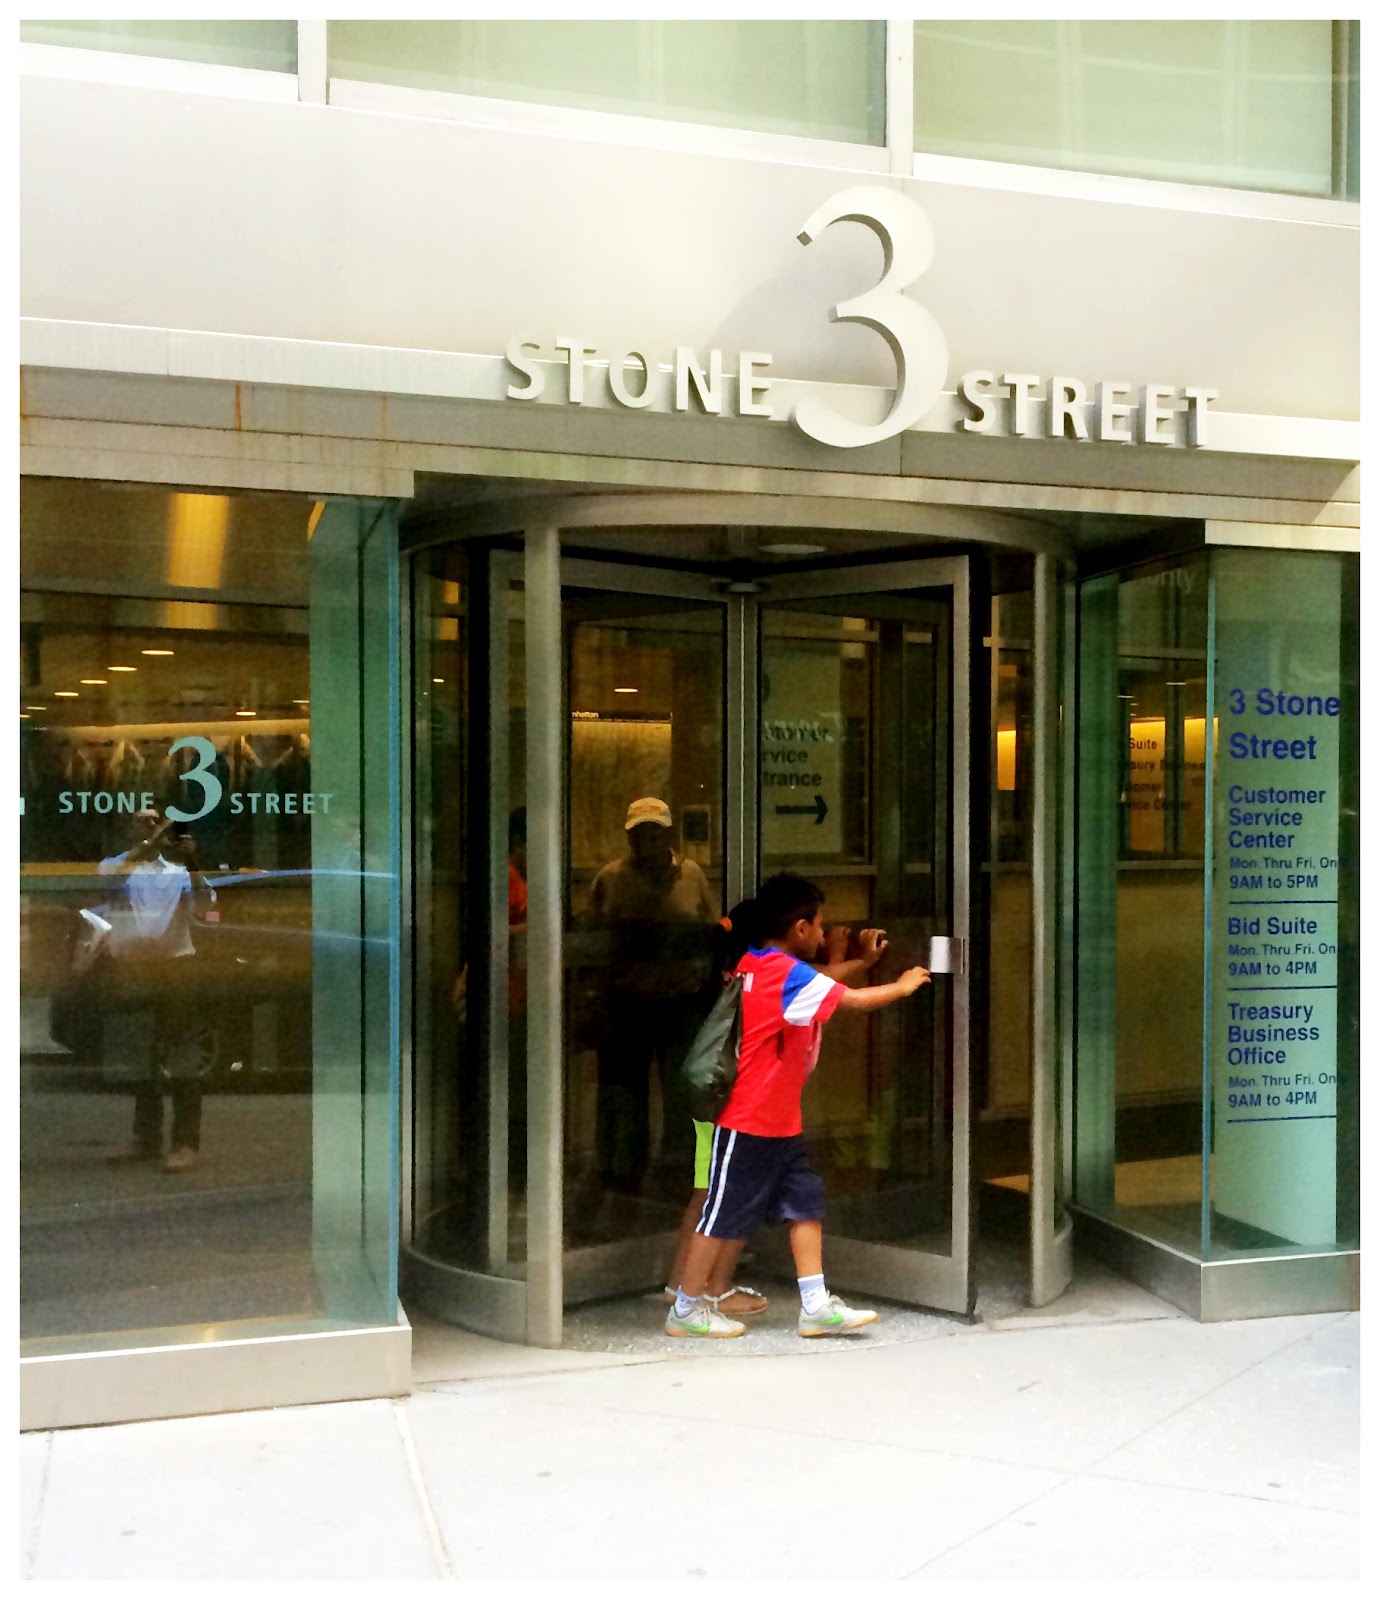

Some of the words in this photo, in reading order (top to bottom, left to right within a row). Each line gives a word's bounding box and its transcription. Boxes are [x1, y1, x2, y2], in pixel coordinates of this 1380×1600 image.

[505, 336, 774, 417] STONE
[795, 185, 950, 448] 3
[957, 369, 1220, 448] STREET
[1229, 688, 1246, 716] 3
[1256, 688, 1340, 717] Stone
[1128, 738, 1158, 750] Suite
[1229, 732, 1317, 760] Street
[762, 748, 809, 764] rvice
[58, 791, 155, 815] STONE
[164, 735, 223, 823] 3
[229, 792, 335, 815] STREET
[762, 770, 823, 787] trance
[1229, 785, 1326, 804] Customer
[1229, 807, 1303, 827] Service
[1228, 830, 1295, 849] Center
[1264, 857, 1292, 869] Thru
[1296, 856, 1316, 869] Fri.
[1319, 856, 1348, 871] On
[1229, 876, 1263, 890] 9AM
[1267, 875, 1282, 889] to
[1286, 875, 1319, 889] 5PM
[1228, 917, 1260, 936] Bid
[1267, 916, 1318, 935] Suite
[1228, 944, 1259, 956] Mon.
[1262, 943, 1291, 956] Thru
[1295, 943, 1315, 955] Fri.
[1318, 942, 1347, 958] On
[1228, 962, 1262, 976] 9AM
[1266, 962, 1281, 976] to
[1285, 961, 1317, 975] 4PM
[1227, 1002, 1314, 1024] Treasury
[1228, 1024, 1320, 1043] Business
[1227, 1047, 1287, 1066] Office
[1228, 1076, 1259, 1088] Mon.
[1262, 1075, 1291, 1087] Thru
[1295, 1073, 1315, 1086] Fri.
[1318, 1072, 1347, 1088] On
[1228, 1094, 1261, 1108] 9AM
[1266, 1094, 1281, 1107] to
[1285, 1091, 1318, 1105] 4PM
